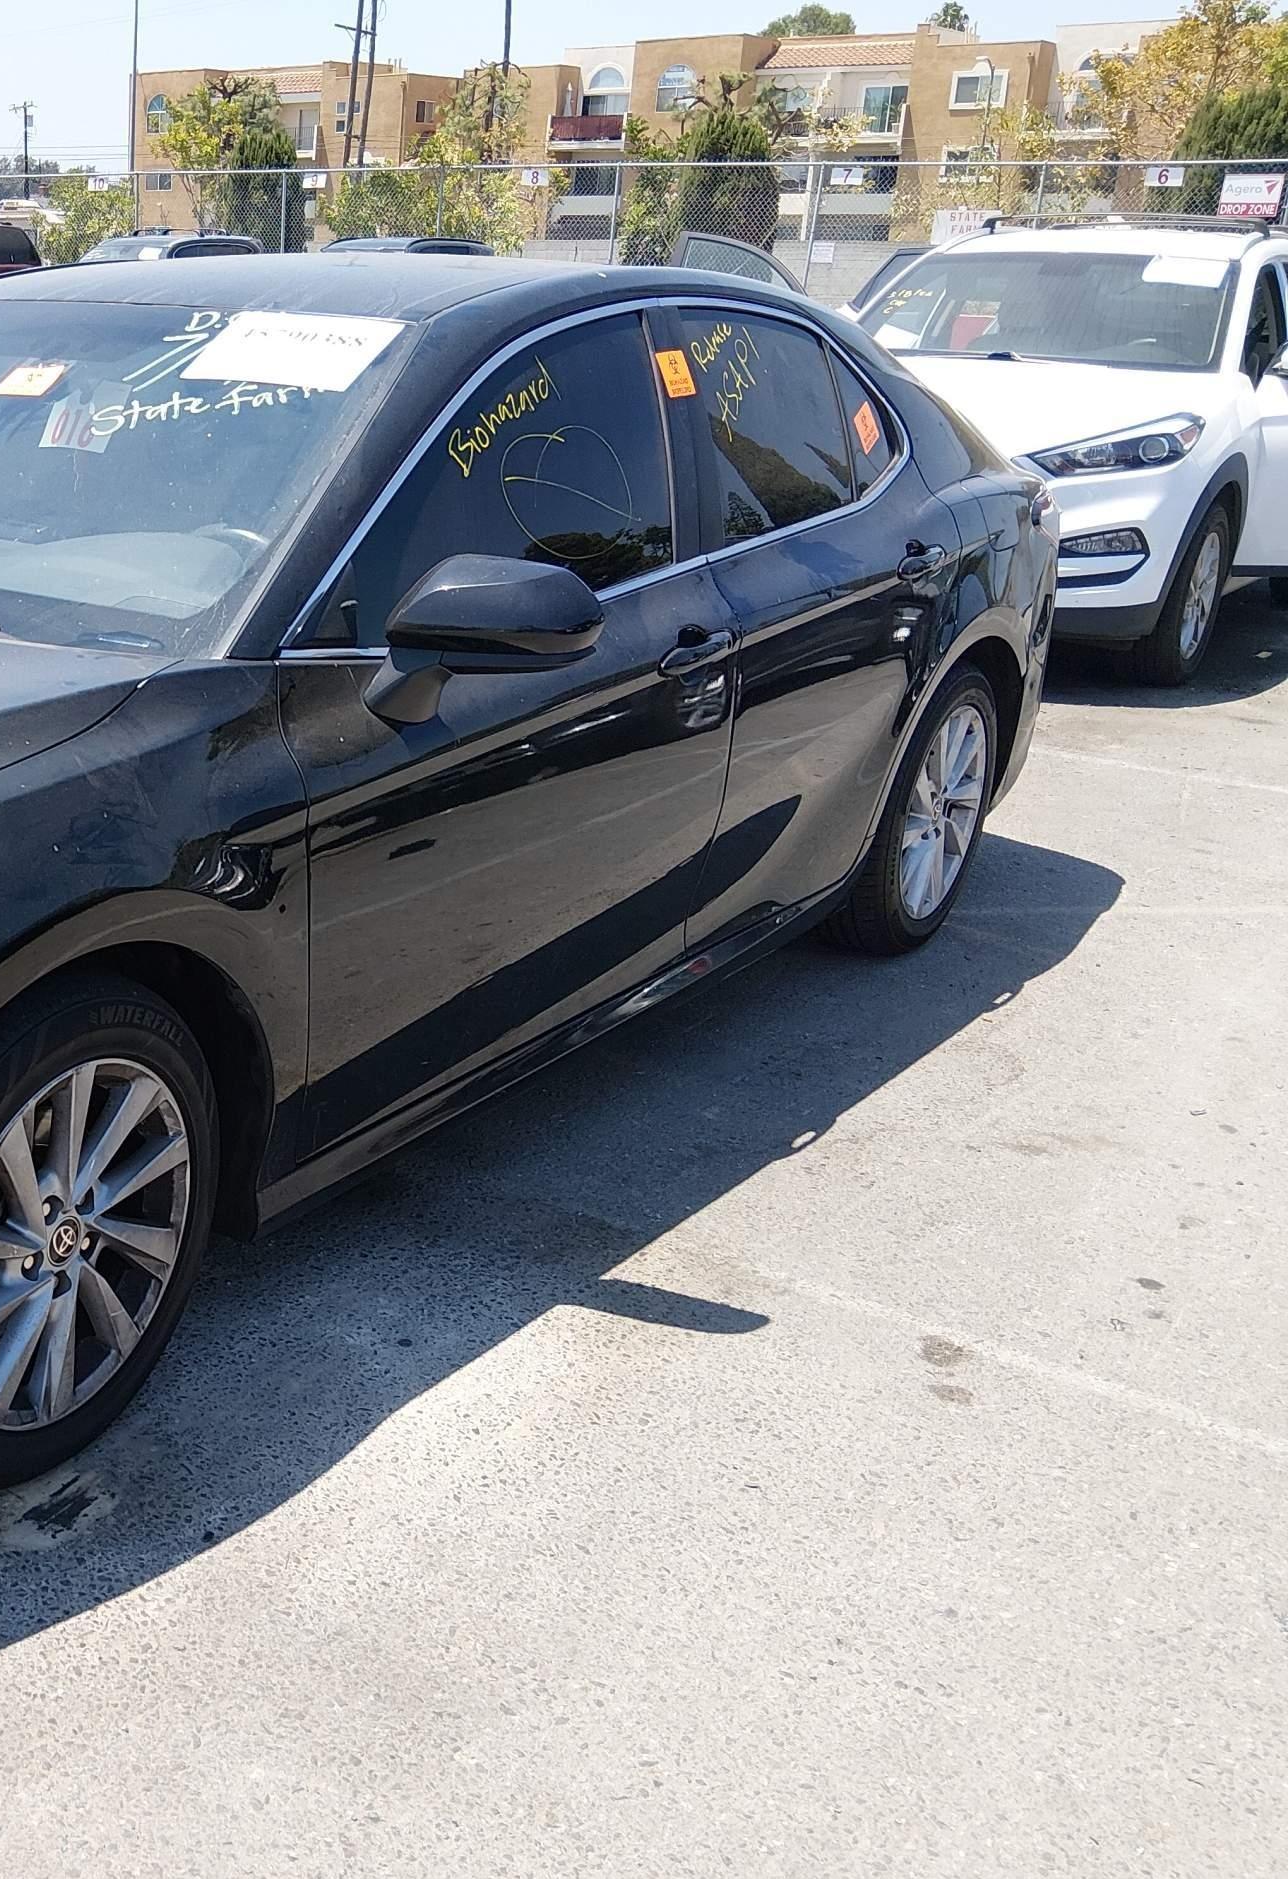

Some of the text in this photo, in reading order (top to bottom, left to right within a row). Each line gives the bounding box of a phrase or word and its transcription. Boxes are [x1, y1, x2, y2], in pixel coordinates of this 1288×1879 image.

[531, 171, 539, 184] 8
[843, 168, 853, 183] 7
[1157, 168, 1170, 185] 6
[92, 177, 105, 190] 10
[1224, 183, 1263, 196] Agero
[1219, 204, 1276, 215] DROP ZONE
[950, 212, 985, 222] STATE
[90, 391, 211, 436] State
[448, 354, 562, 478] Biohazard
[99, 1005, 185, 1047] WATERFALL
